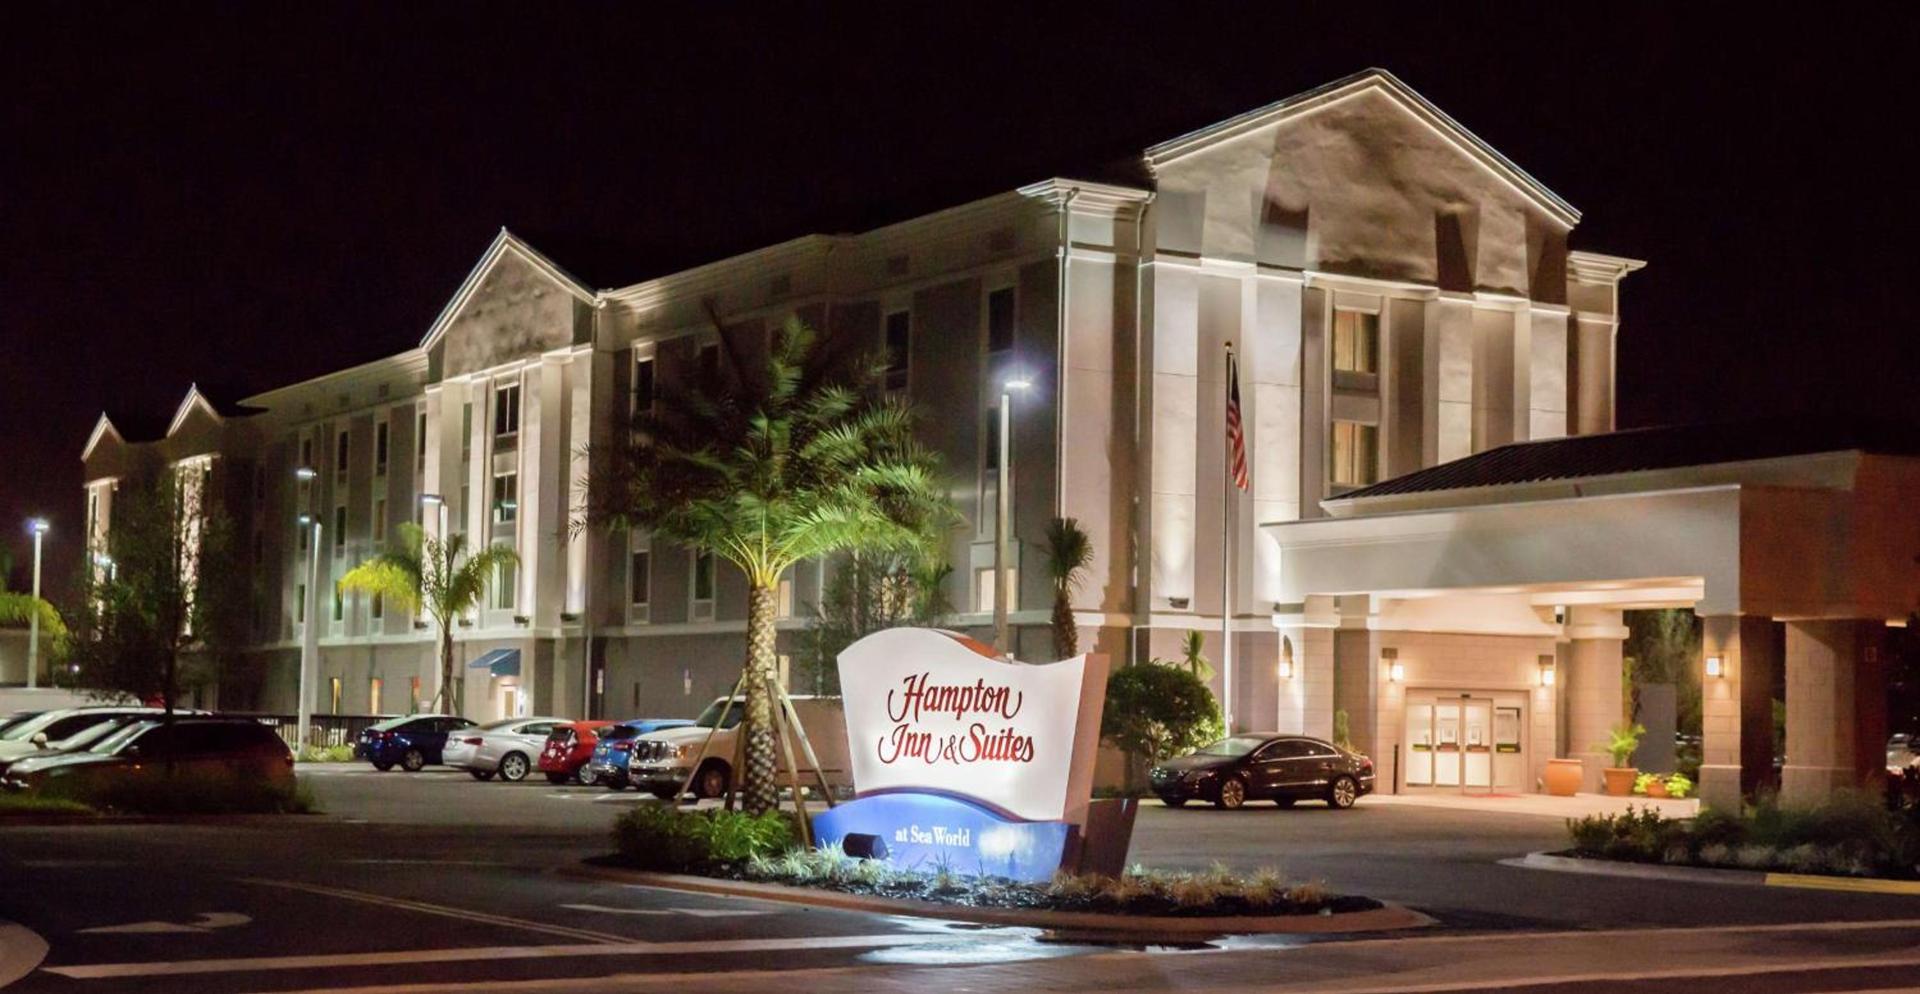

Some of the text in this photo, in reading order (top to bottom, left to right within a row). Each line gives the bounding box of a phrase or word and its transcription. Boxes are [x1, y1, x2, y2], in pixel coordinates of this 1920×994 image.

[887, 672, 1022, 722] Hampton
[878, 722, 1034, 765] Inn & Suites
[895, 826, 970, 847] at Sea World
